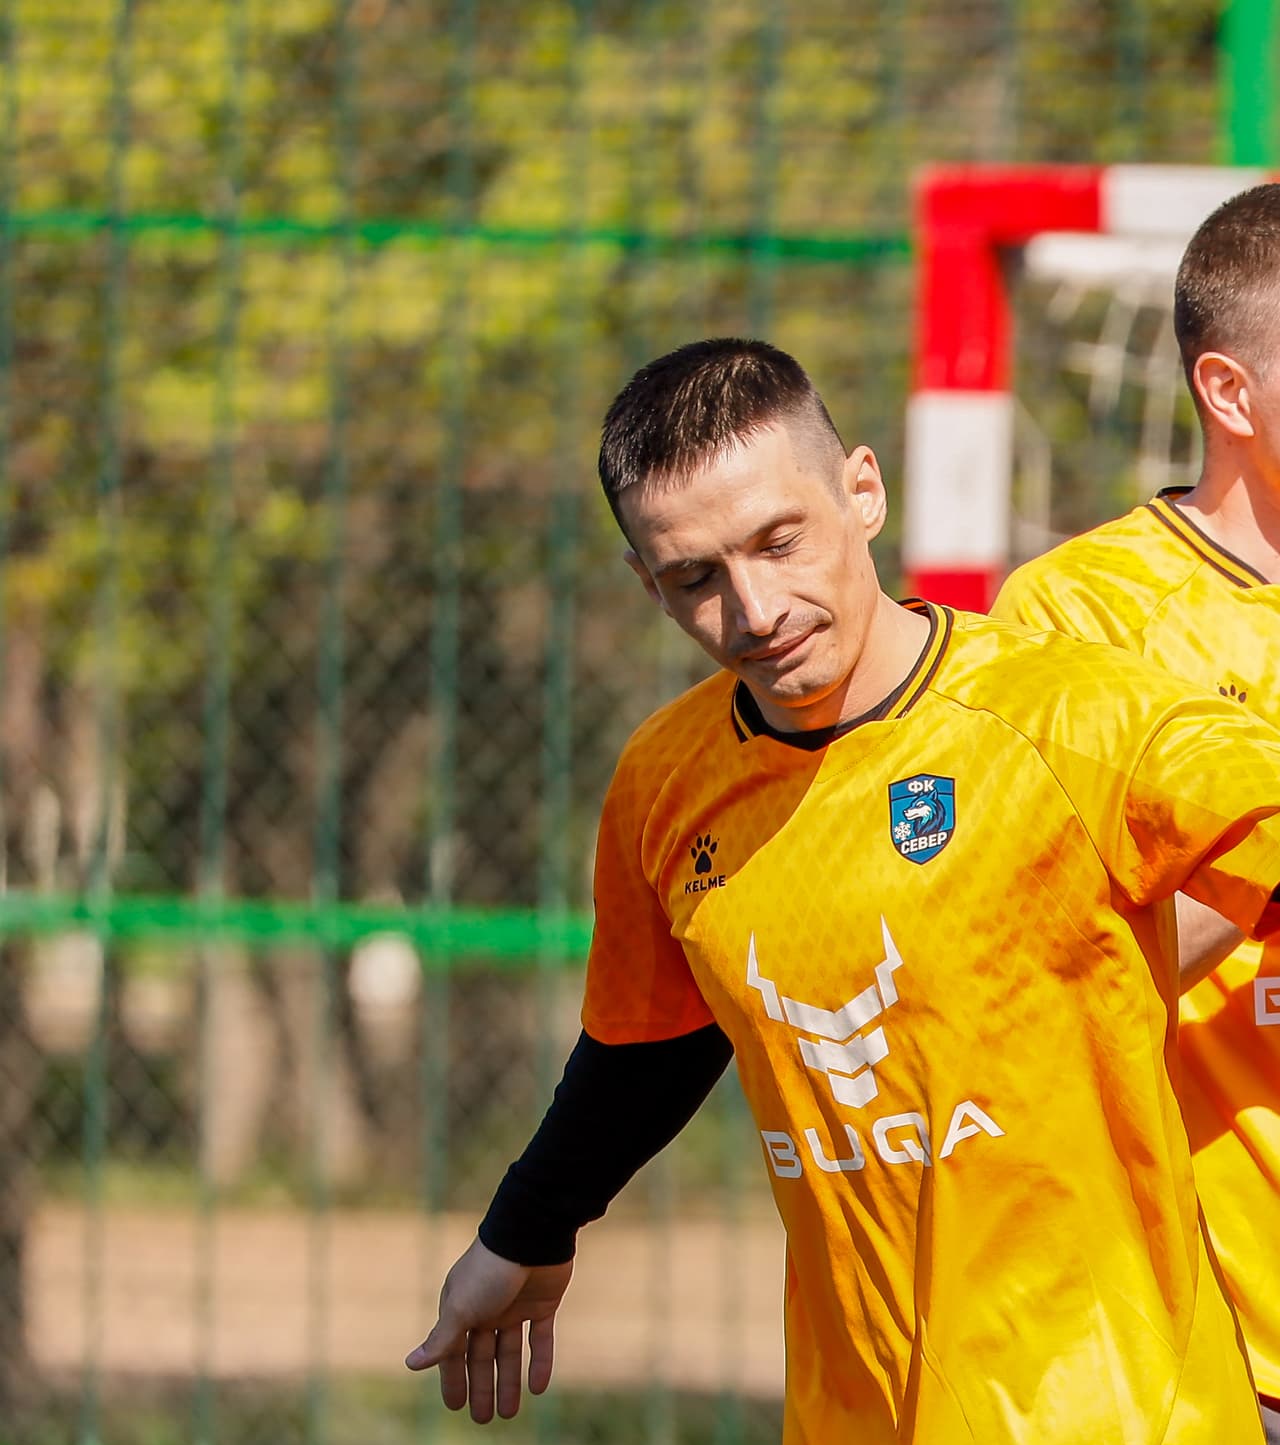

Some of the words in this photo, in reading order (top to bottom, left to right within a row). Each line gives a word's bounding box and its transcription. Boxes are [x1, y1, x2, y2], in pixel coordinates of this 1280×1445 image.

[907, 779, 937, 793] ФК
[900, 831, 948, 855] СЕВЕР
[684, 874, 727, 895] KELME
[760, 1099, 1007, 1180] BUQA
